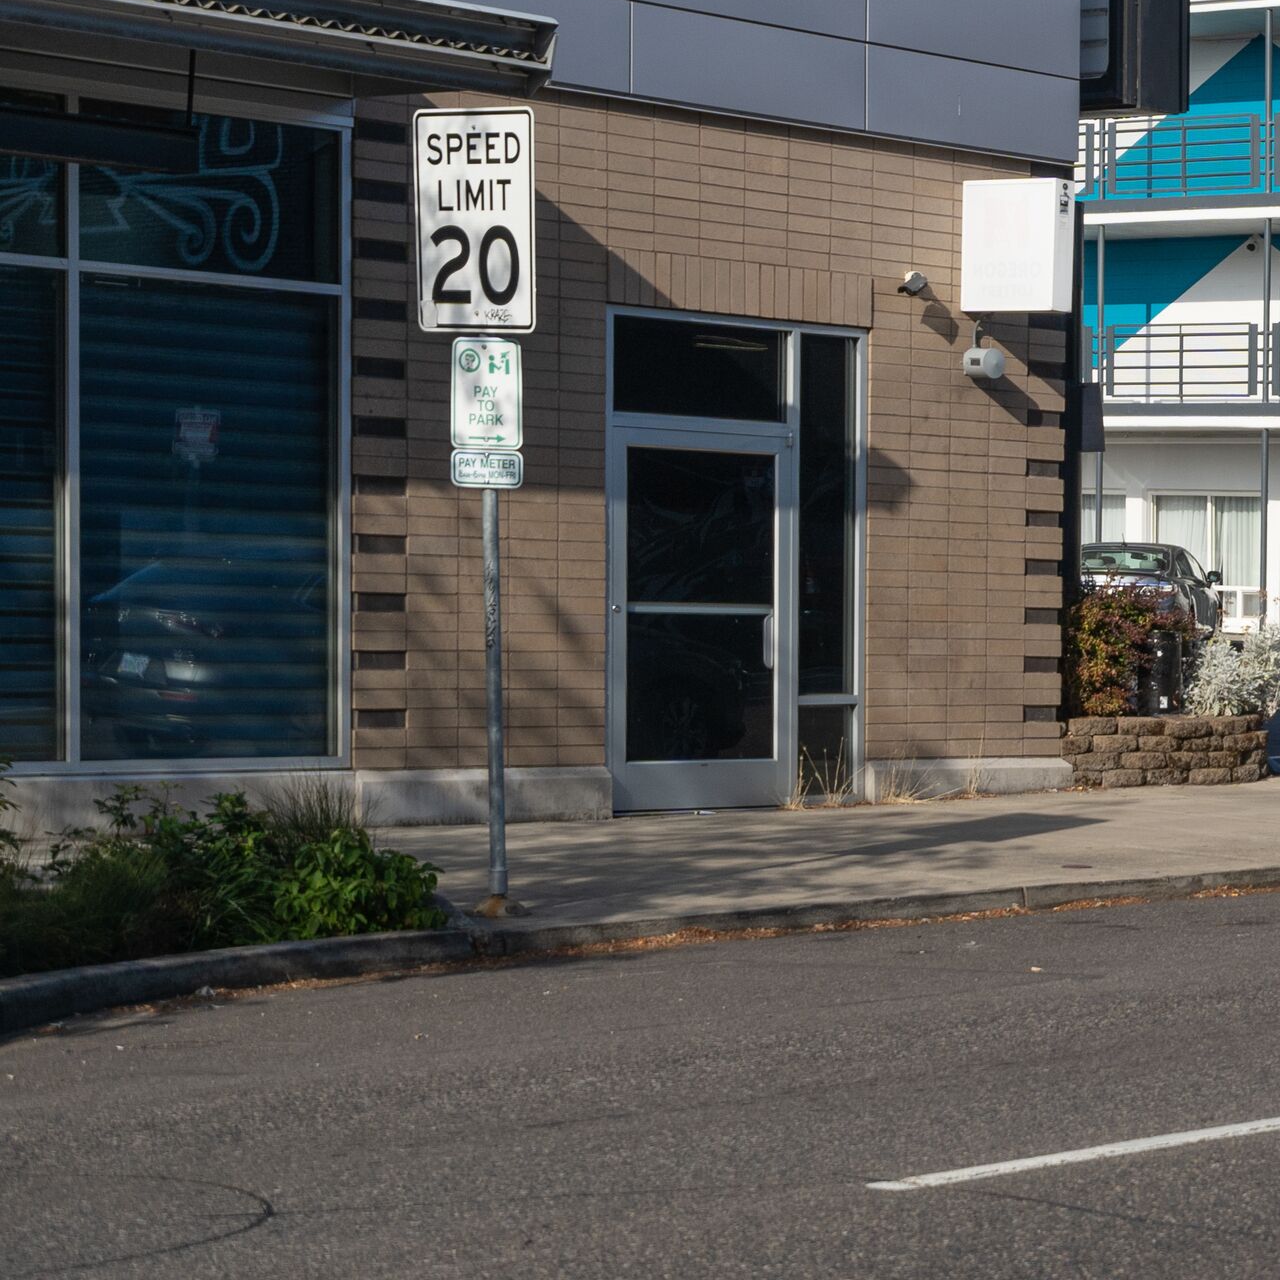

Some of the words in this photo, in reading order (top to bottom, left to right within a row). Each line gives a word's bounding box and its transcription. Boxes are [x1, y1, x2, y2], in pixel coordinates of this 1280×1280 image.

[427, 132, 520, 165] SPEED
[438, 179, 511, 211] LIMIT
[430, 225, 519, 305] 20
[473, 385, 498, 398] PAY
[477, 400, 495, 412] TO
[468, 413, 504, 426] PARK
[458, 457, 477, 468] PAY
[480, 458, 516, 470] METER
